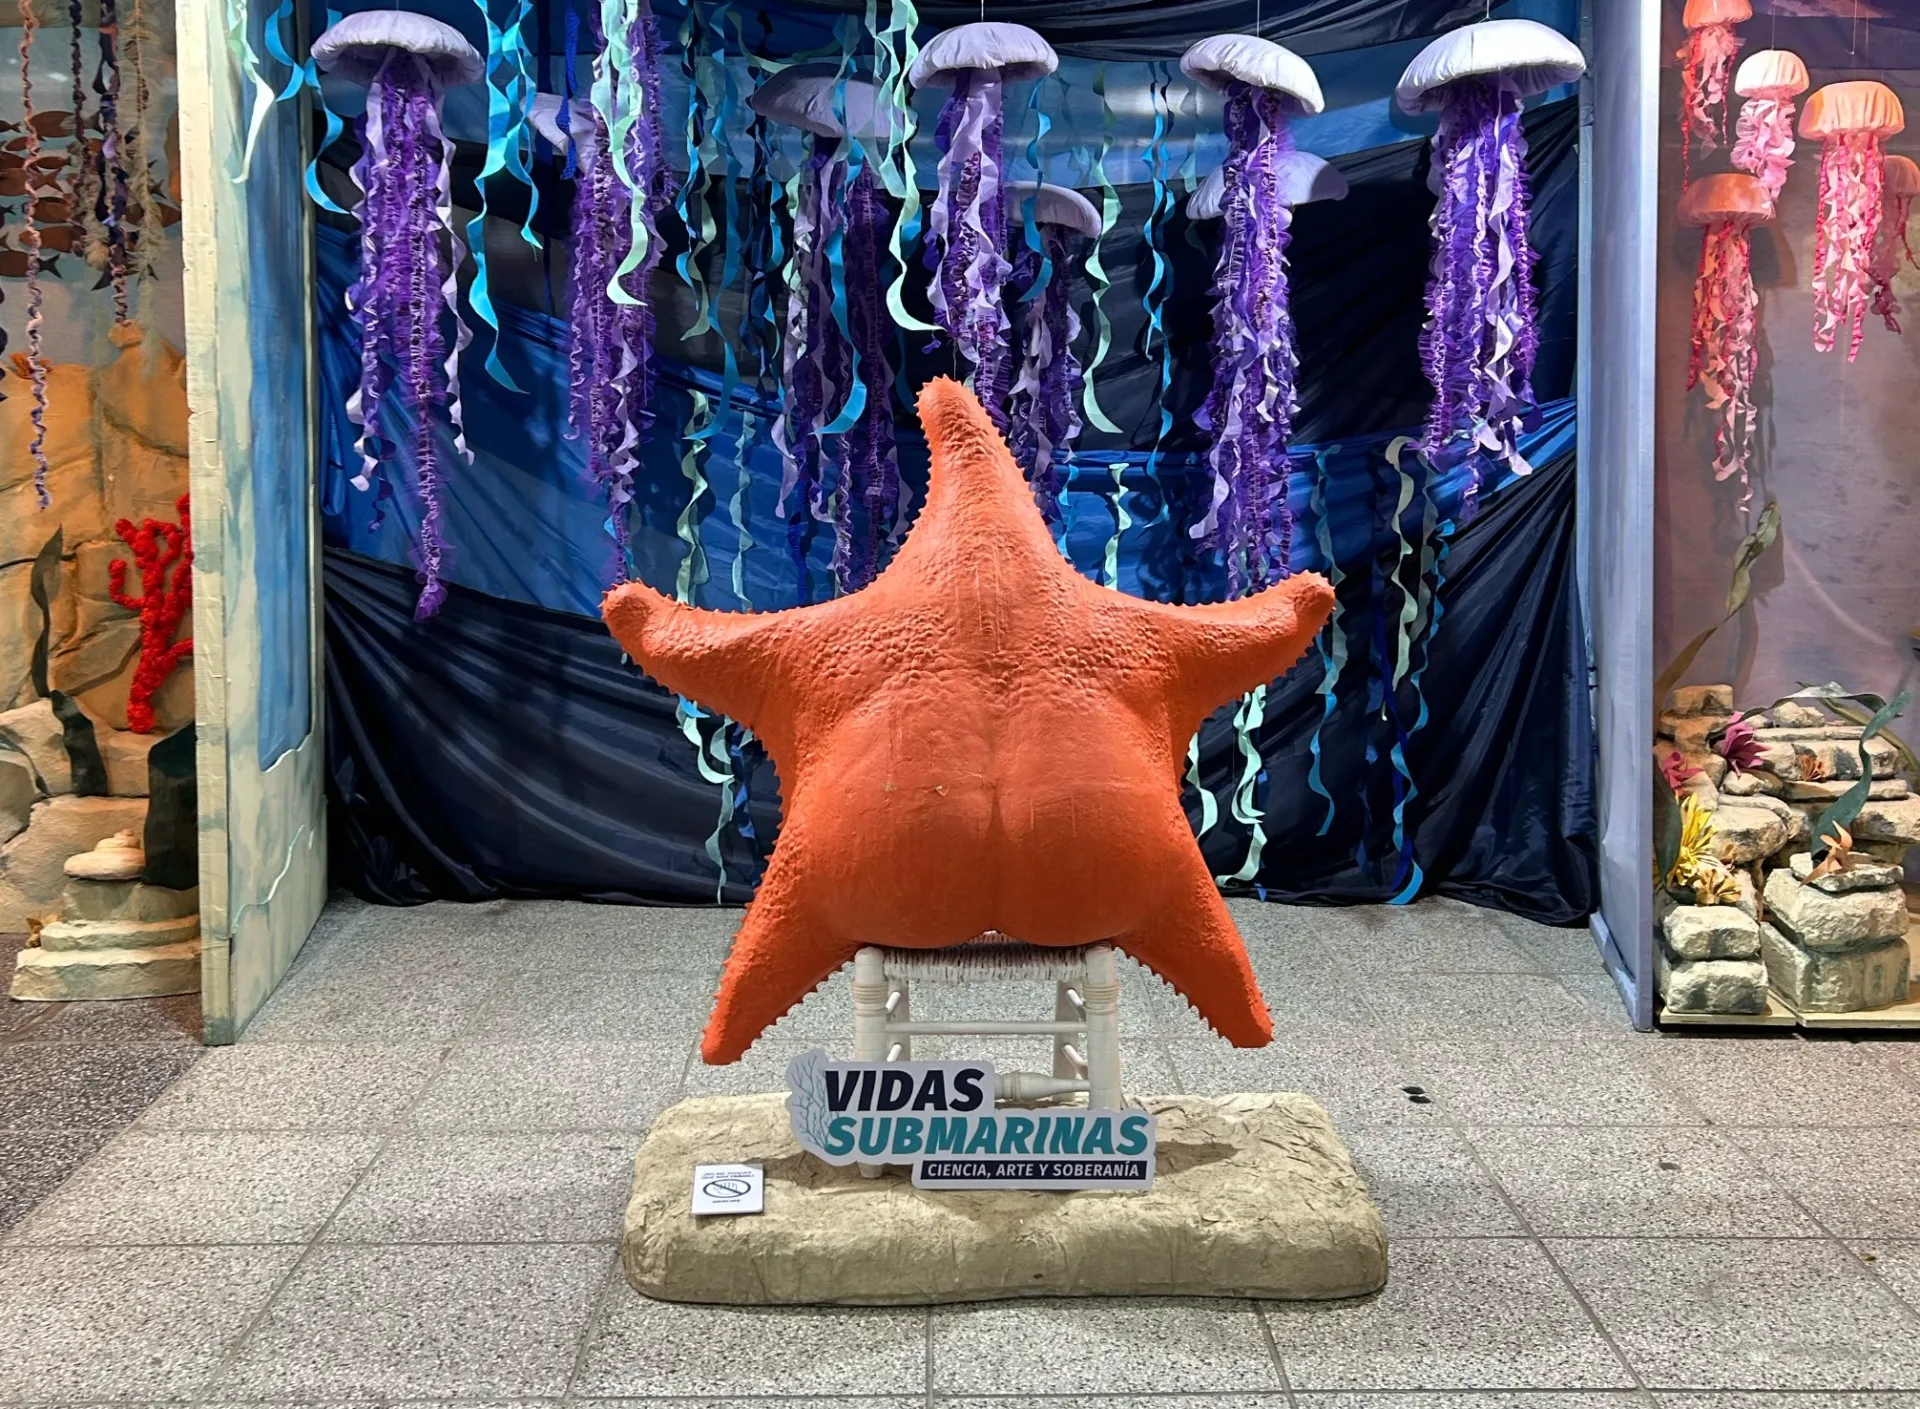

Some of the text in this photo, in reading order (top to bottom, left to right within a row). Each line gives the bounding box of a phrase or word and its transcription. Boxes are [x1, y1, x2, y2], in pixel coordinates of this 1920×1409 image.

[824, 1068, 985, 1112] VIDAS
[825, 1115, 1149, 1156] SUBMARINAS
[927, 1160, 1140, 1179] CIENCIA, ARTE Y SOBERANÍA
